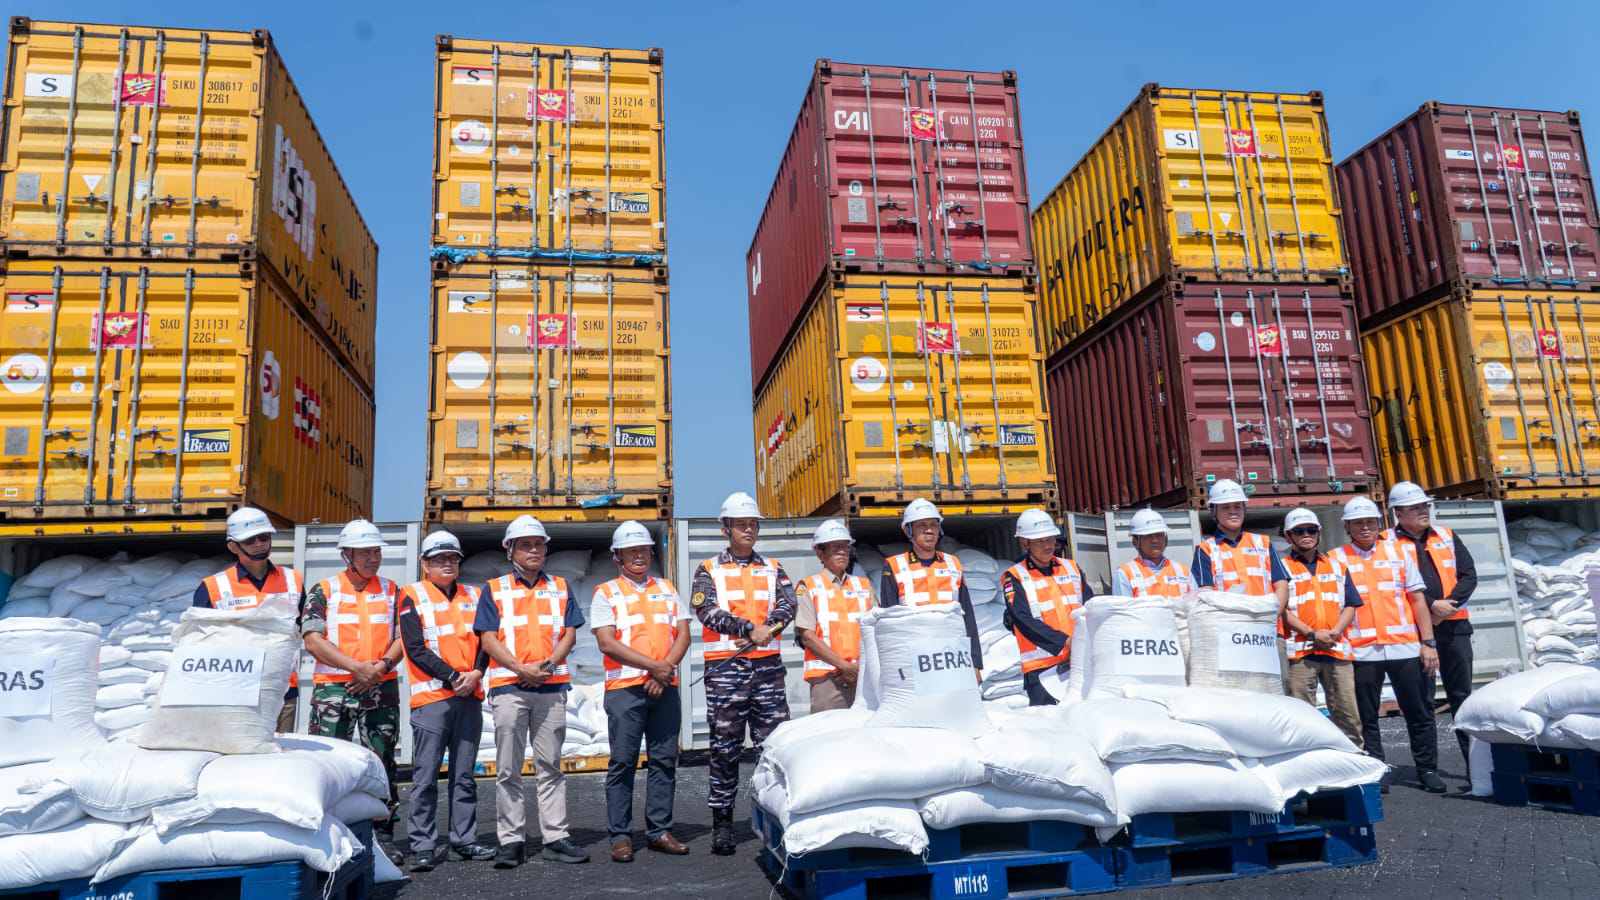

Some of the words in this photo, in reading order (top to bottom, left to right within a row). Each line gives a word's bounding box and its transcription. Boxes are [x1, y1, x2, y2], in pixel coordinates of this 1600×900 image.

[40, 77, 58, 93] S
[172, 80, 196, 89] SIKU
[208, 81, 243, 91] 308617
[612, 96, 643, 107] 311214
[834, 110, 869, 130] CAI
[858, 306, 871, 319] S
[193, 319, 229, 330] 311131
[583, 320, 604, 331] SIKU
[616, 320, 648, 332] 309467
[992, 327, 1020, 337] 310723
[190, 438, 229, 452] BEACON
[621, 432, 656, 446] BEACON
[1231, 632, 1275, 648] GARAM
[1120, 639, 1179, 656] BERAS
[181, 657, 254, 673] GARAM
